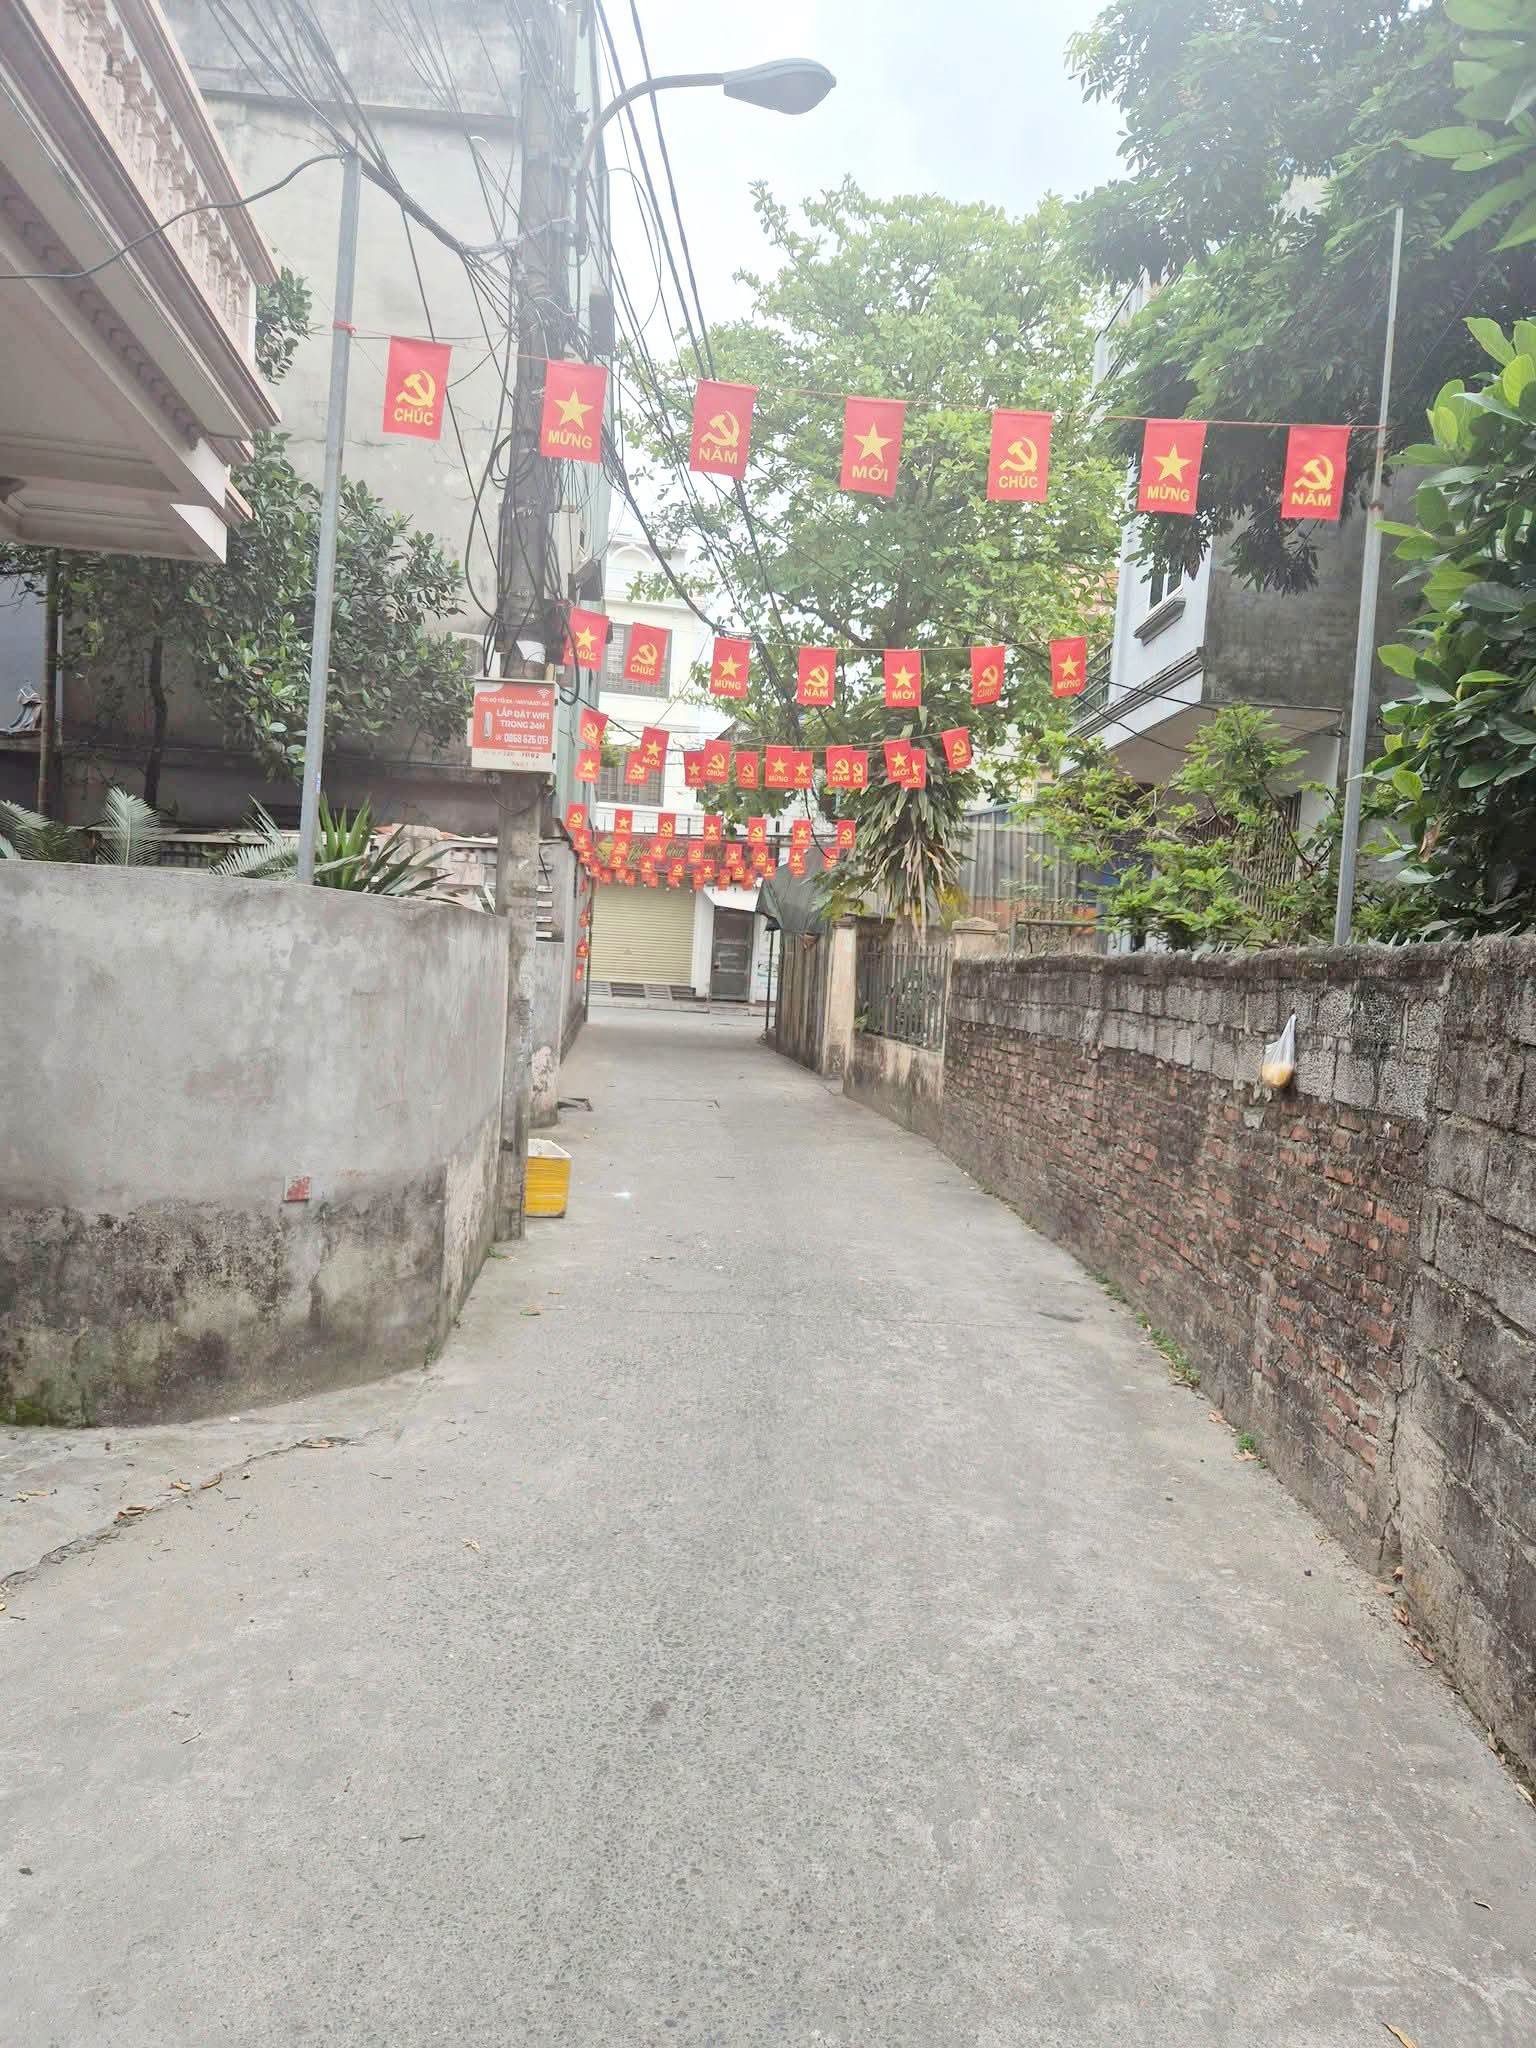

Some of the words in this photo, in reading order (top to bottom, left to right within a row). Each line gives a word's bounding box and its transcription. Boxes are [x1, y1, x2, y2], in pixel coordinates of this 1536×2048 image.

[394, 407, 434, 426] CHÚC
[548, 429, 592, 450] MỪNG
[699, 446, 738, 465] NĂM
[852, 464, 888, 482] MỚI
[998, 473, 1038, 489] CHÚC
[1147, 483, 1190, 502] MỪNG
[1291, 490, 1331, 506] NĂM
[715, 679, 742, 690] MỪNG
[804, 687, 829, 697] NĂM
[892, 689, 915, 700] MỚI
[501, 720, 528, 729] TRONG
